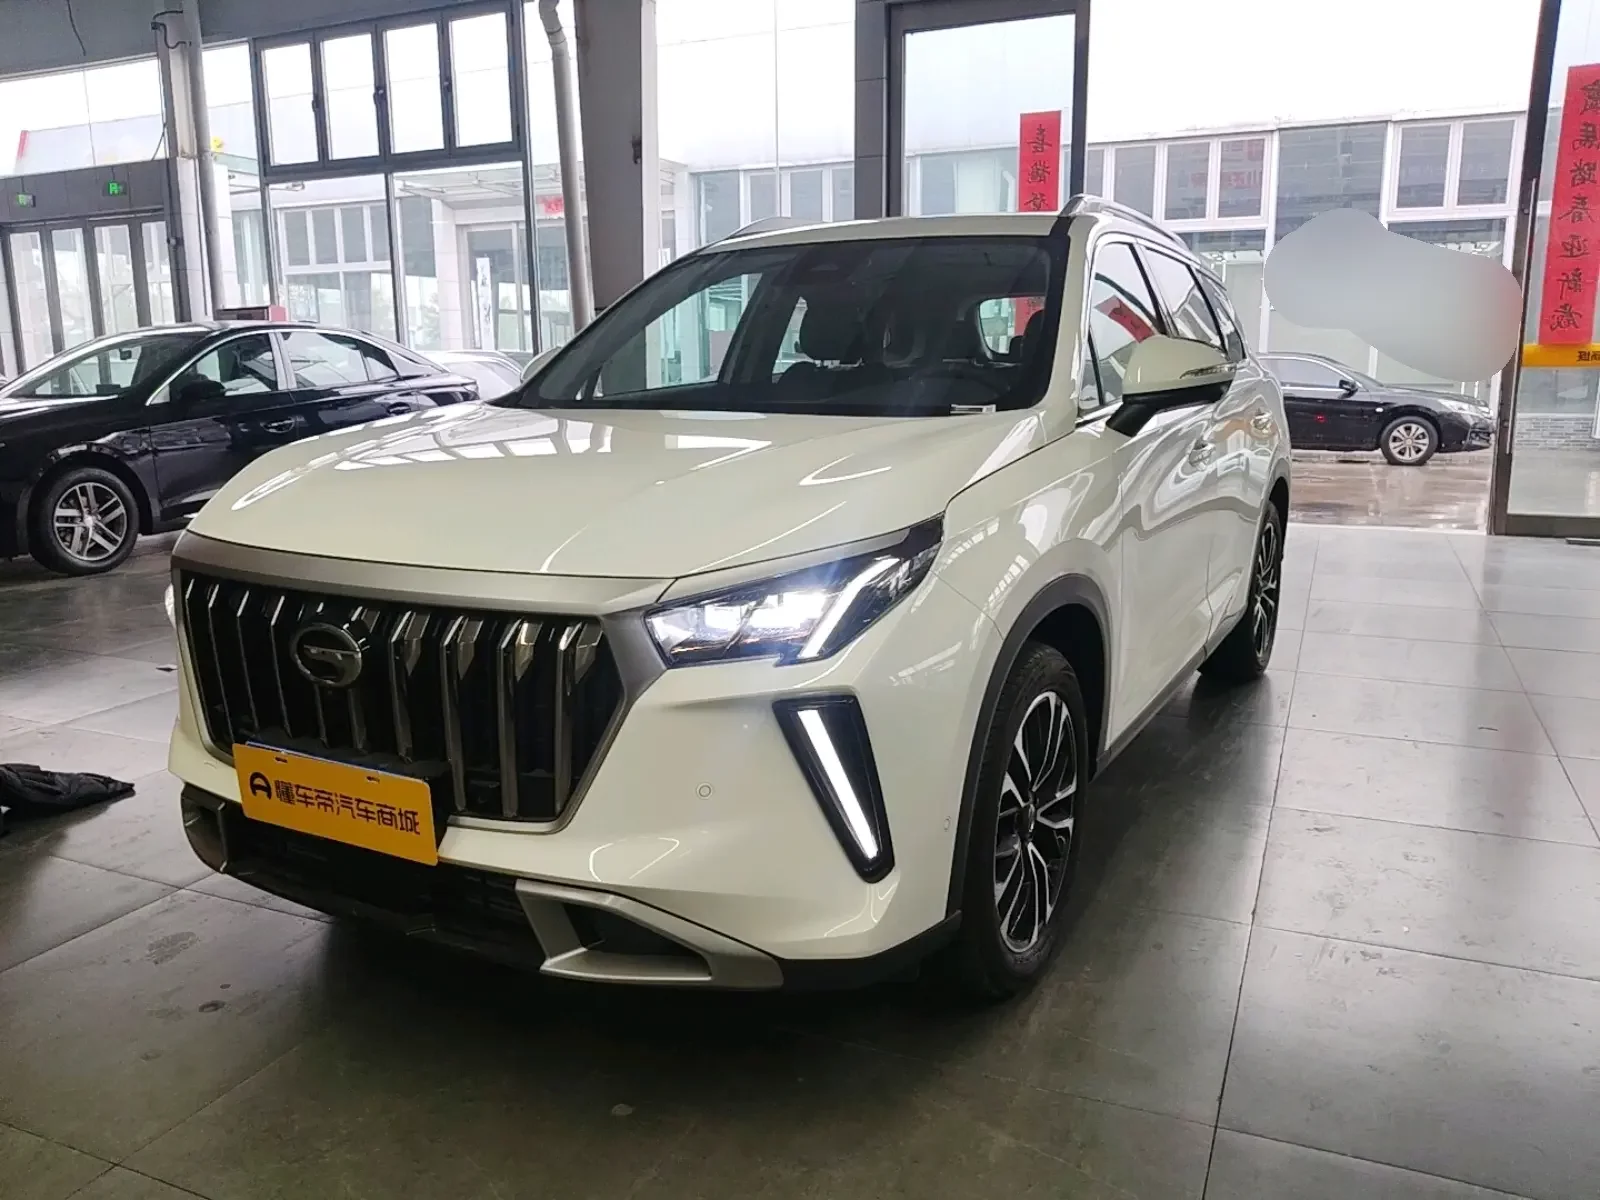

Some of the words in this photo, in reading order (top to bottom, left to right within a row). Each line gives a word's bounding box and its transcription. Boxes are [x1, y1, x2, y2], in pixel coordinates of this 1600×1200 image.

[274, 779, 421, 835] 懂车帝汽车商城
